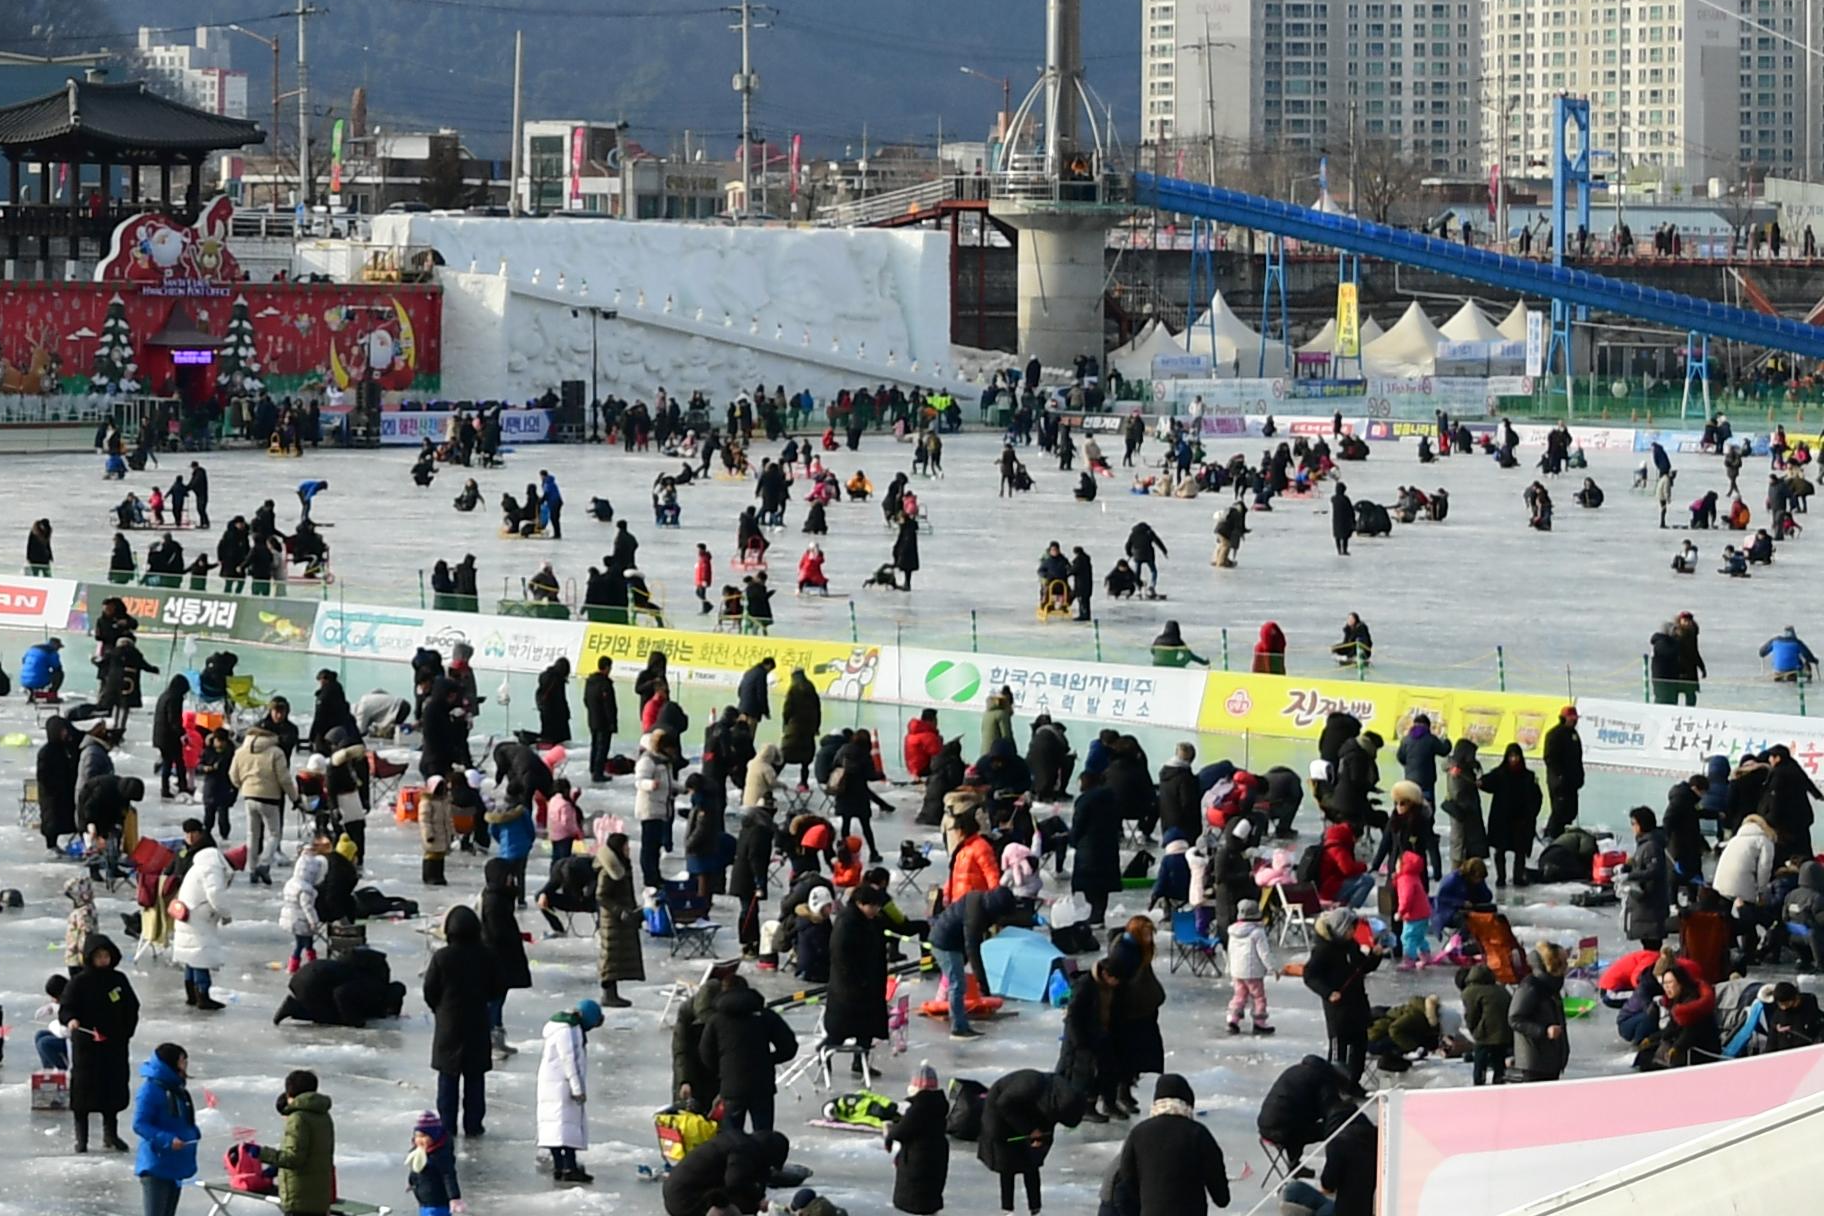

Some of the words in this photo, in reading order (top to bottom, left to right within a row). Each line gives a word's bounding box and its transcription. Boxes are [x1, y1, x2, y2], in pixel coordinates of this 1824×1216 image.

[162, 596, 237, 629] 선등거리
[587, 633, 631, 657] 타키와
[699, 643, 730, 666] 화천
